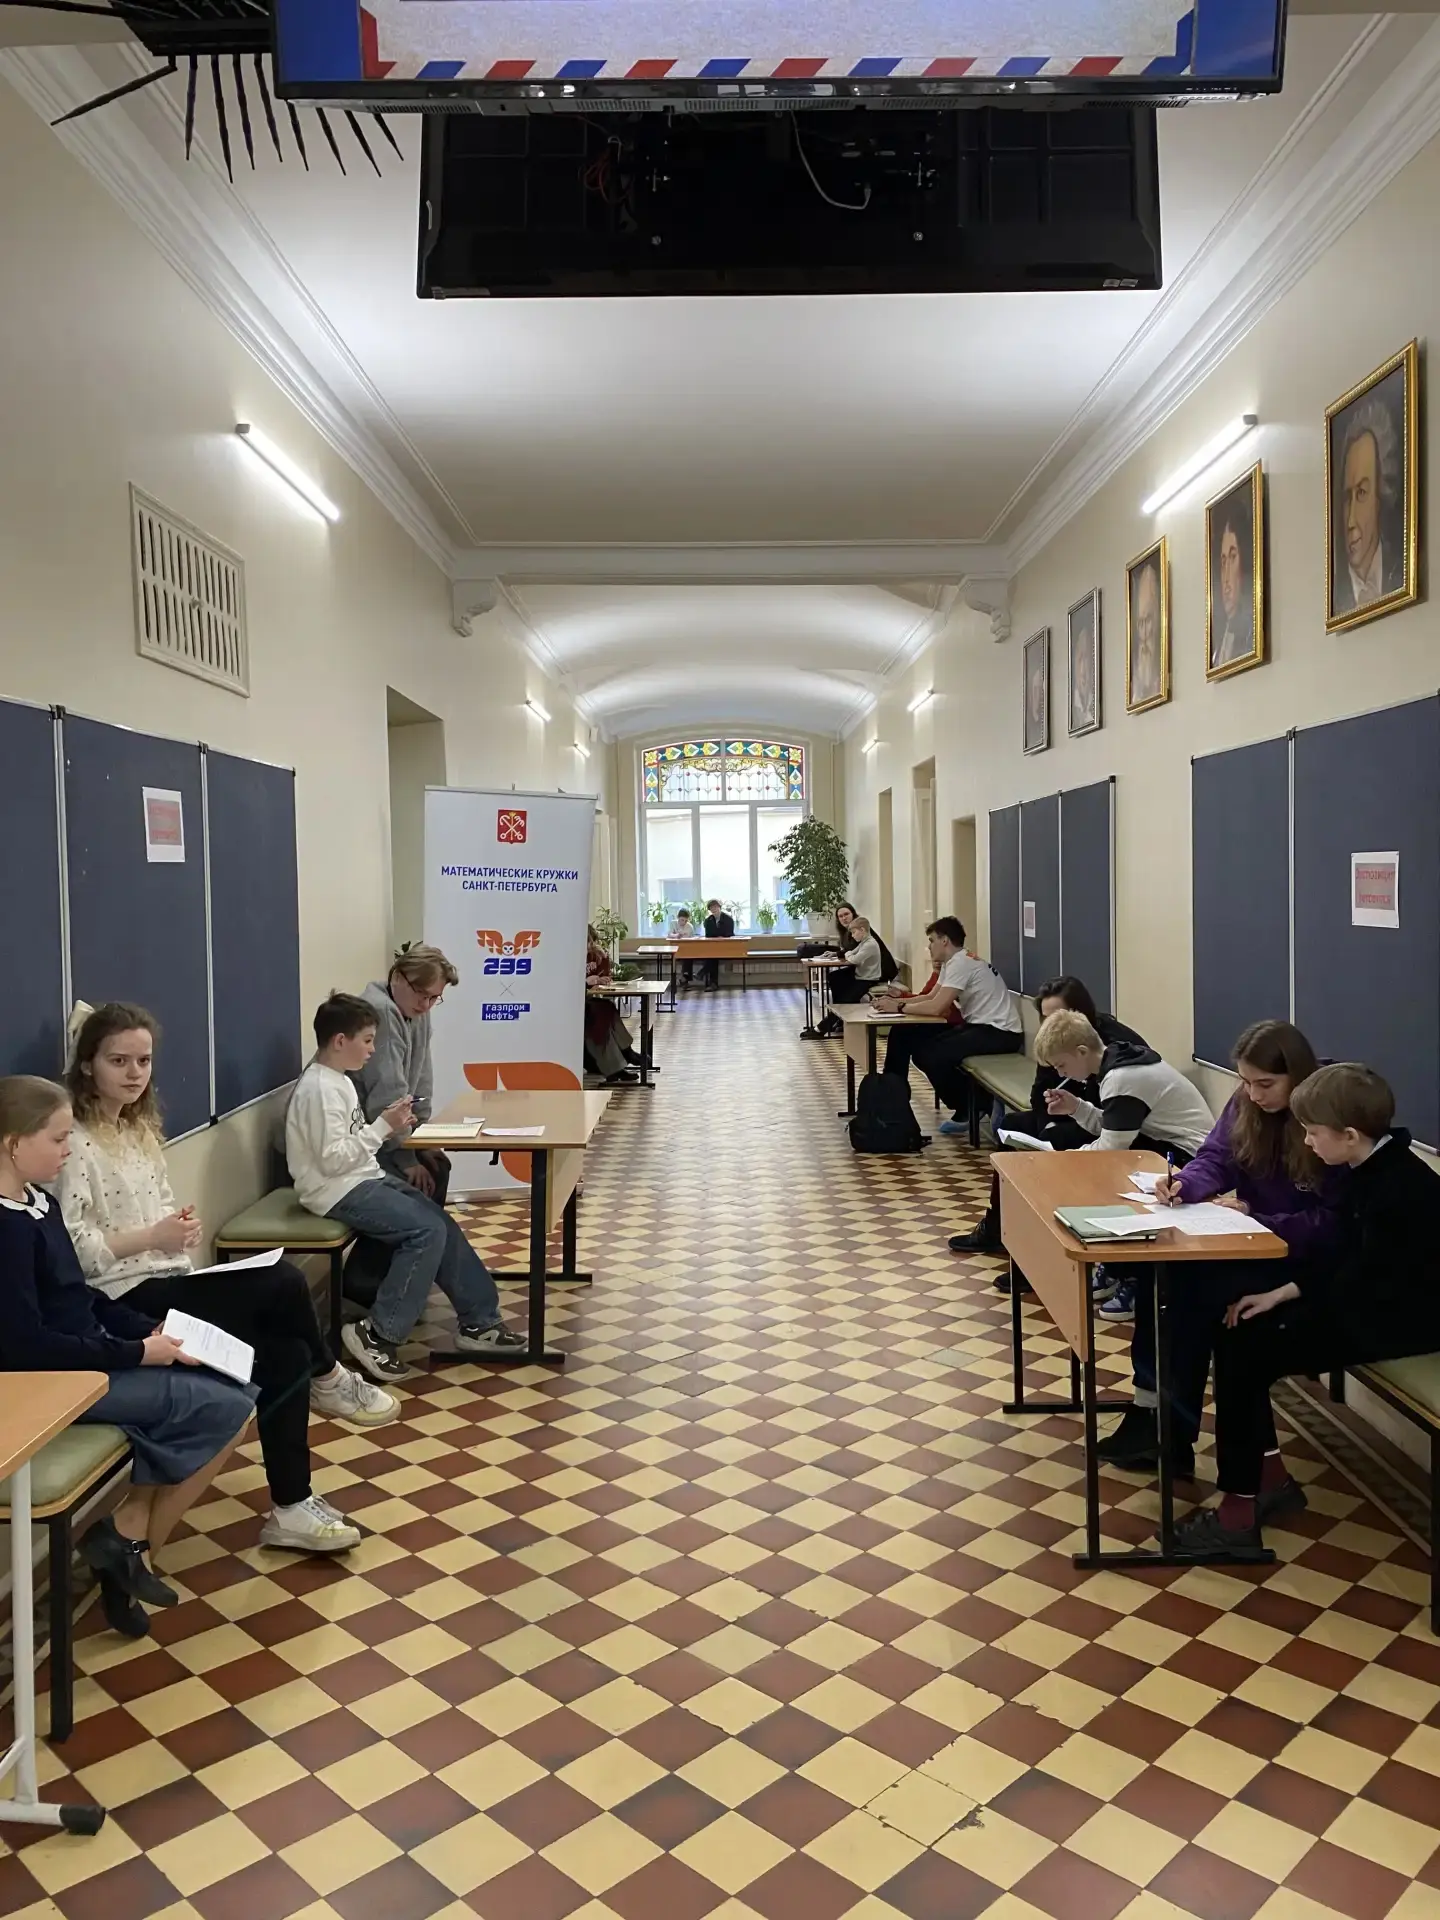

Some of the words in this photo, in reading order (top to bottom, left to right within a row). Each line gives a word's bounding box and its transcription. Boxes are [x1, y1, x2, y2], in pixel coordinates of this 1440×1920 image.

[441, 865, 534, 879] МАТЕМАТИЧЕСКИЕ
[536, 869, 578, 880] КРУЖКИ
[462, 880, 558, 893] САНКТ-ПЕТЕРБУРГА
[483, 957, 532, 975] 239
[485, 1003, 525, 1013] газпром
[485, 1011, 514, 1021] нефть
